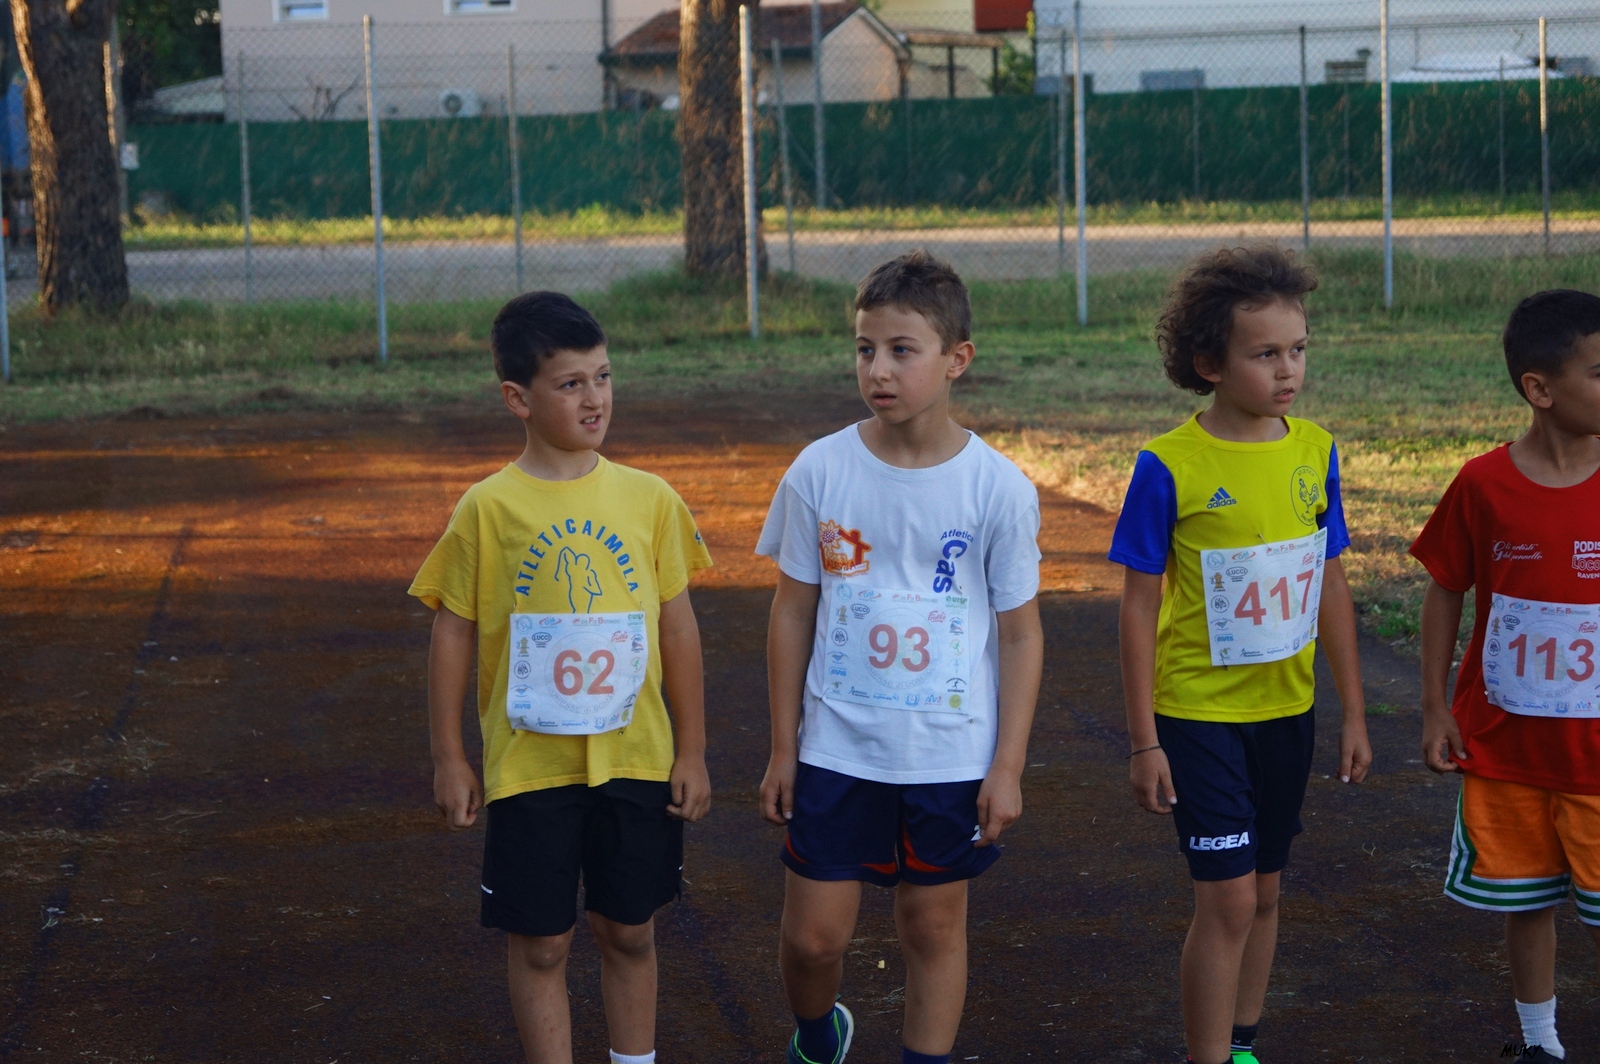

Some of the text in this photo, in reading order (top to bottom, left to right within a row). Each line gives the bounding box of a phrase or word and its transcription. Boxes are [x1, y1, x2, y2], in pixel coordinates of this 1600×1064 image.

[1206, 497, 1237, 510] adidas
[940, 529, 974, 543] Atletica
[1228, 568, 1246, 576] LUCCI
[1234, 568, 1315, 626] 417
[851, 605, 869, 613] LUCCI
[868, 623, 931, 673] 93
[1508, 633, 1595, 682] 113
[553, 649, 615, 696] 62
[1189, 831, 1250, 851] LEGEA
